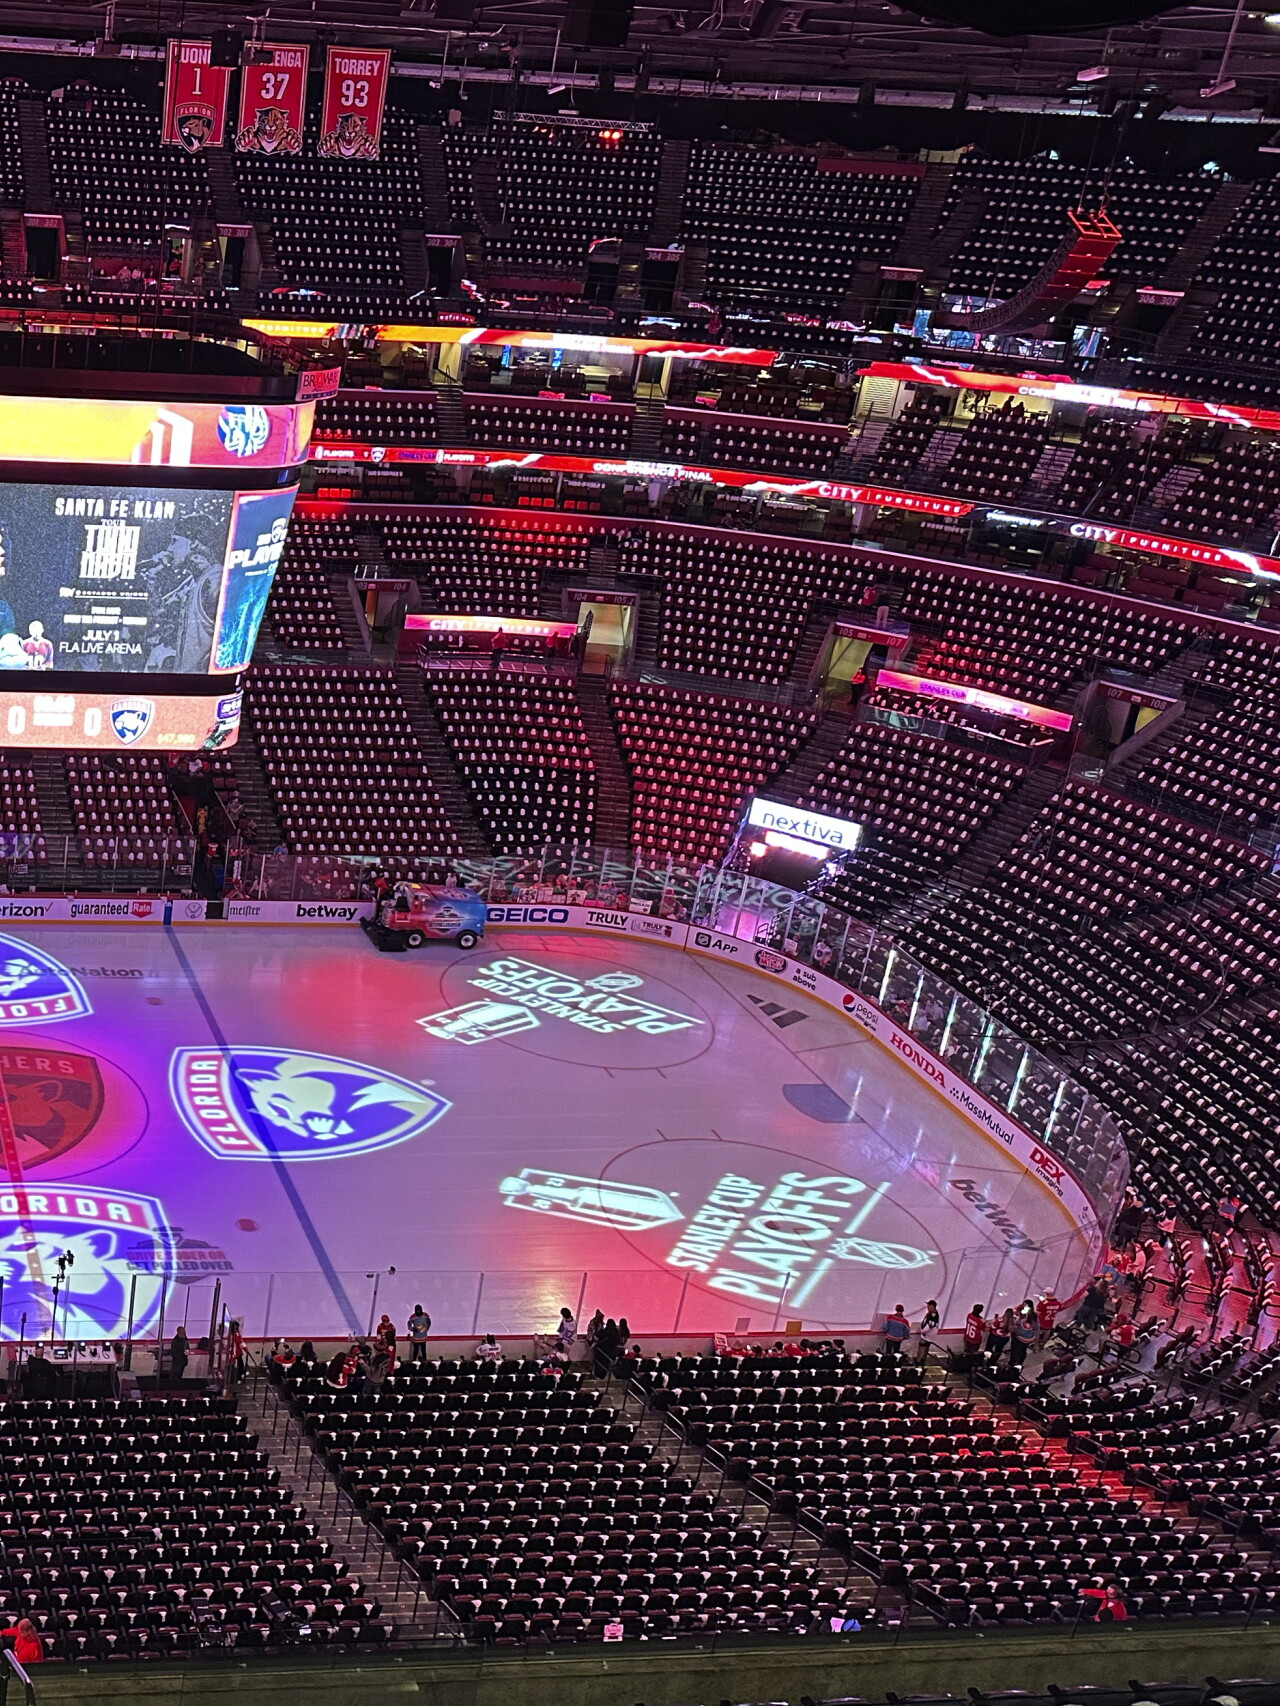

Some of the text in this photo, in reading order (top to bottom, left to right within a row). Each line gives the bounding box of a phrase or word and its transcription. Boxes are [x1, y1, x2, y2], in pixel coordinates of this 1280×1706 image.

[334, 58, 381, 77] TORREY
[192, 68, 202, 94] 1
[261, 72, 289, 100] 37
[340, 79, 370, 107] 93
[1138, 294, 1178, 306] 306 307
[678, 469, 714, 481] FINAL
[55, 497, 175, 519] SANTA FE KLAN
[818, 485, 961, 513] CITY FURNITURE
[1070, 523, 1222, 561] CITY FURNITURE
[430, 619, 465, 630] CITY
[82, 630, 120, 642] JULY 1
[839, 627, 902, 646] 105 107
[59, 642, 143, 654] FLA LIVE ARENA
[1107, 688, 1167, 710] 107 108
[763, 813, 843, 844] nextiva
[71, 901, 151, 918] guaranteed Rate
[296, 904, 358, 921] betway
[486, 907, 569, 923] GEICO
[587, 911, 628, 926] TRULY
[642, 920, 664, 930] TRULY
[793, 975, 817, 991] above
[803, 970, 817, 982] sub
[469, 978, 626, 1033] STANLEY CUP
[478, 960, 694, 1035] PLAYOFFS
[856, 1003, 879, 1025] pepsi
[890, 1032, 946, 1089] HONDA
[190, 1060, 250, 1145] FLORIDA
[960, 1091, 1015, 1146] MassMutual
[1030, 1147, 1065, 1185] DEX
[665, 1175, 764, 1272] STANLEY CUP
[949, 1179, 1047, 1253] betway
[708, 1172, 866, 1303] PLAYOFFS
[201, 1261, 234, 1270] OVER
[966, 1323, 977, 1339] 16
